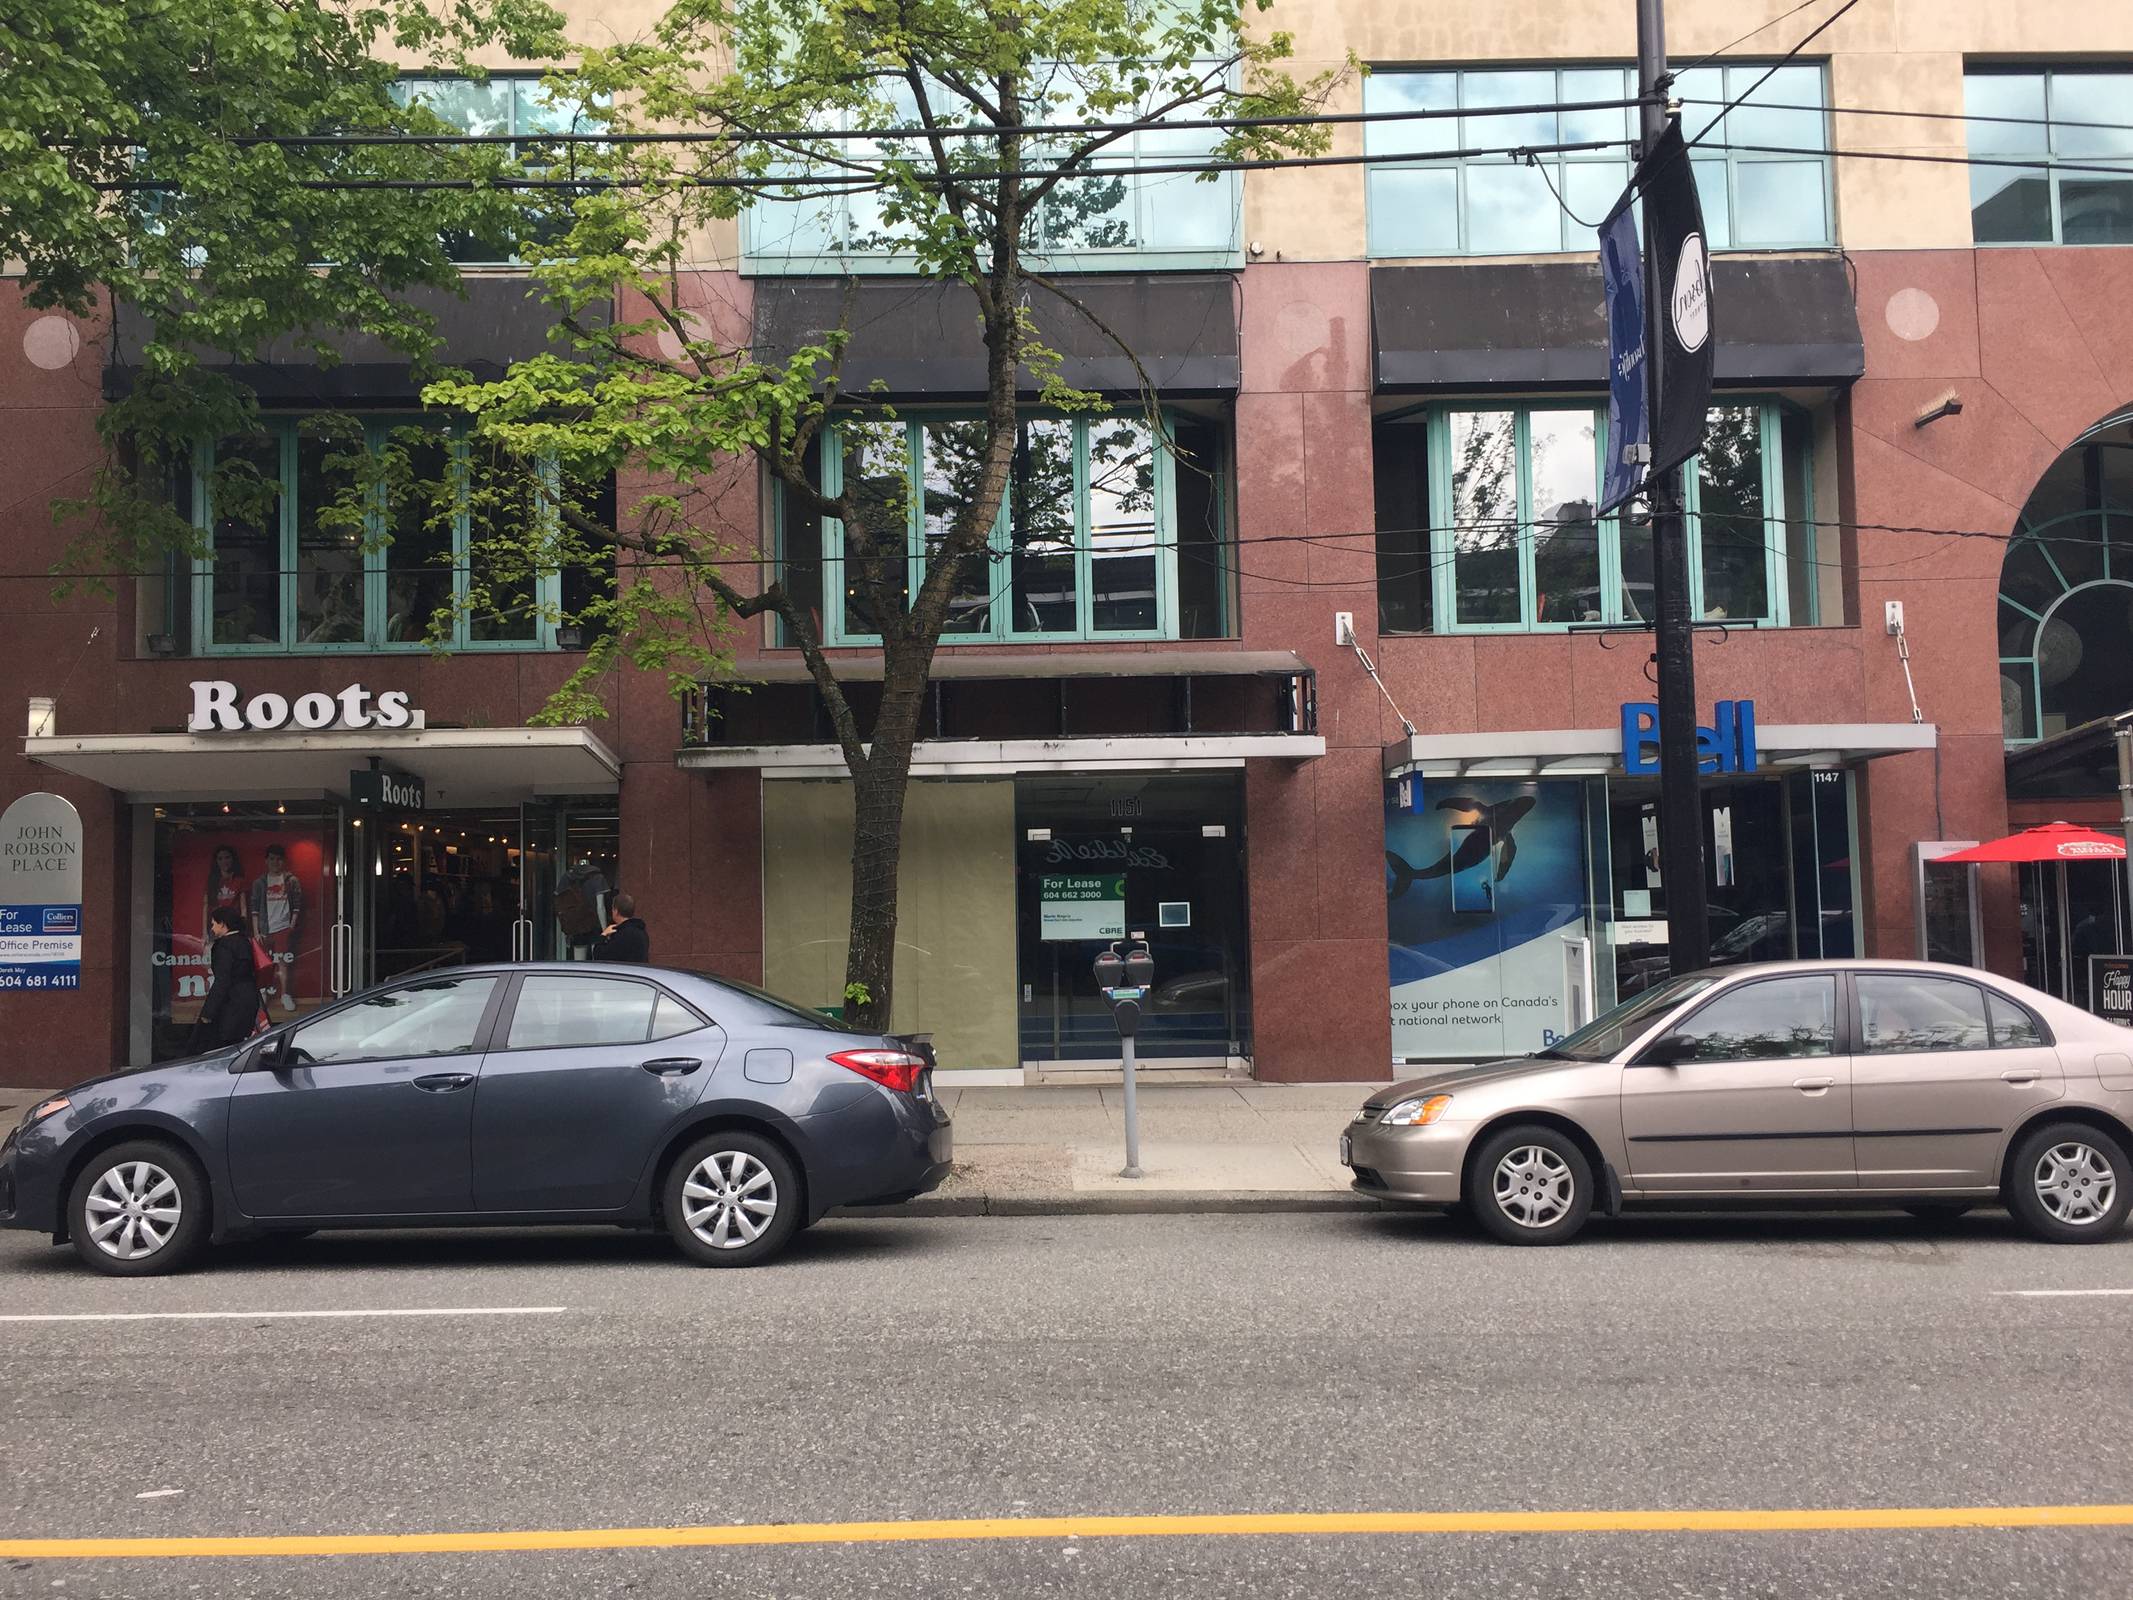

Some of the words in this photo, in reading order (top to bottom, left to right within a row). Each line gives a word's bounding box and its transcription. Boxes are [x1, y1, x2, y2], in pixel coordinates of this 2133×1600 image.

[189, 680, 409, 731] Roots
[1620, 700, 1757, 775] Bell
[1815, 773, 1839, 783] 1147
[382, 774, 422, 809] Roots
[1110, 799, 1142, 817] 1151
[17, 825, 62, 840] JOHN
[5, 842, 76, 856] ROBSON
[12, 858, 67, 872] PLACE
[1043, 878, 1063, 889] For
[1067, 878, 1102, 888] Lease
[1043, 891, 1060, 899] 604
[1080, 891, 1102, 899] 3000
[0, 909, 18, 920] For
[47, 912, 74, 921] Colliers
[0, 922, 33, 933] Lease
[0, 940, 29, 950] Office
[32, 940, 74, 950] Premise
[0, 975, 22, 987] 604
[26, 975, 47, 987] 681
[51, 975, 77, 987] 4111
[1411, 1001, 1439, 1013] your
[1442, 998, 1480, 1011] phone
[1483, 1000, 1498, 1008] on
[1501, 996, 1558, 1008] Canada's
[2103, 989, 2133, 1011] HOUR
[1399, 1014, 1448, 1026] national
